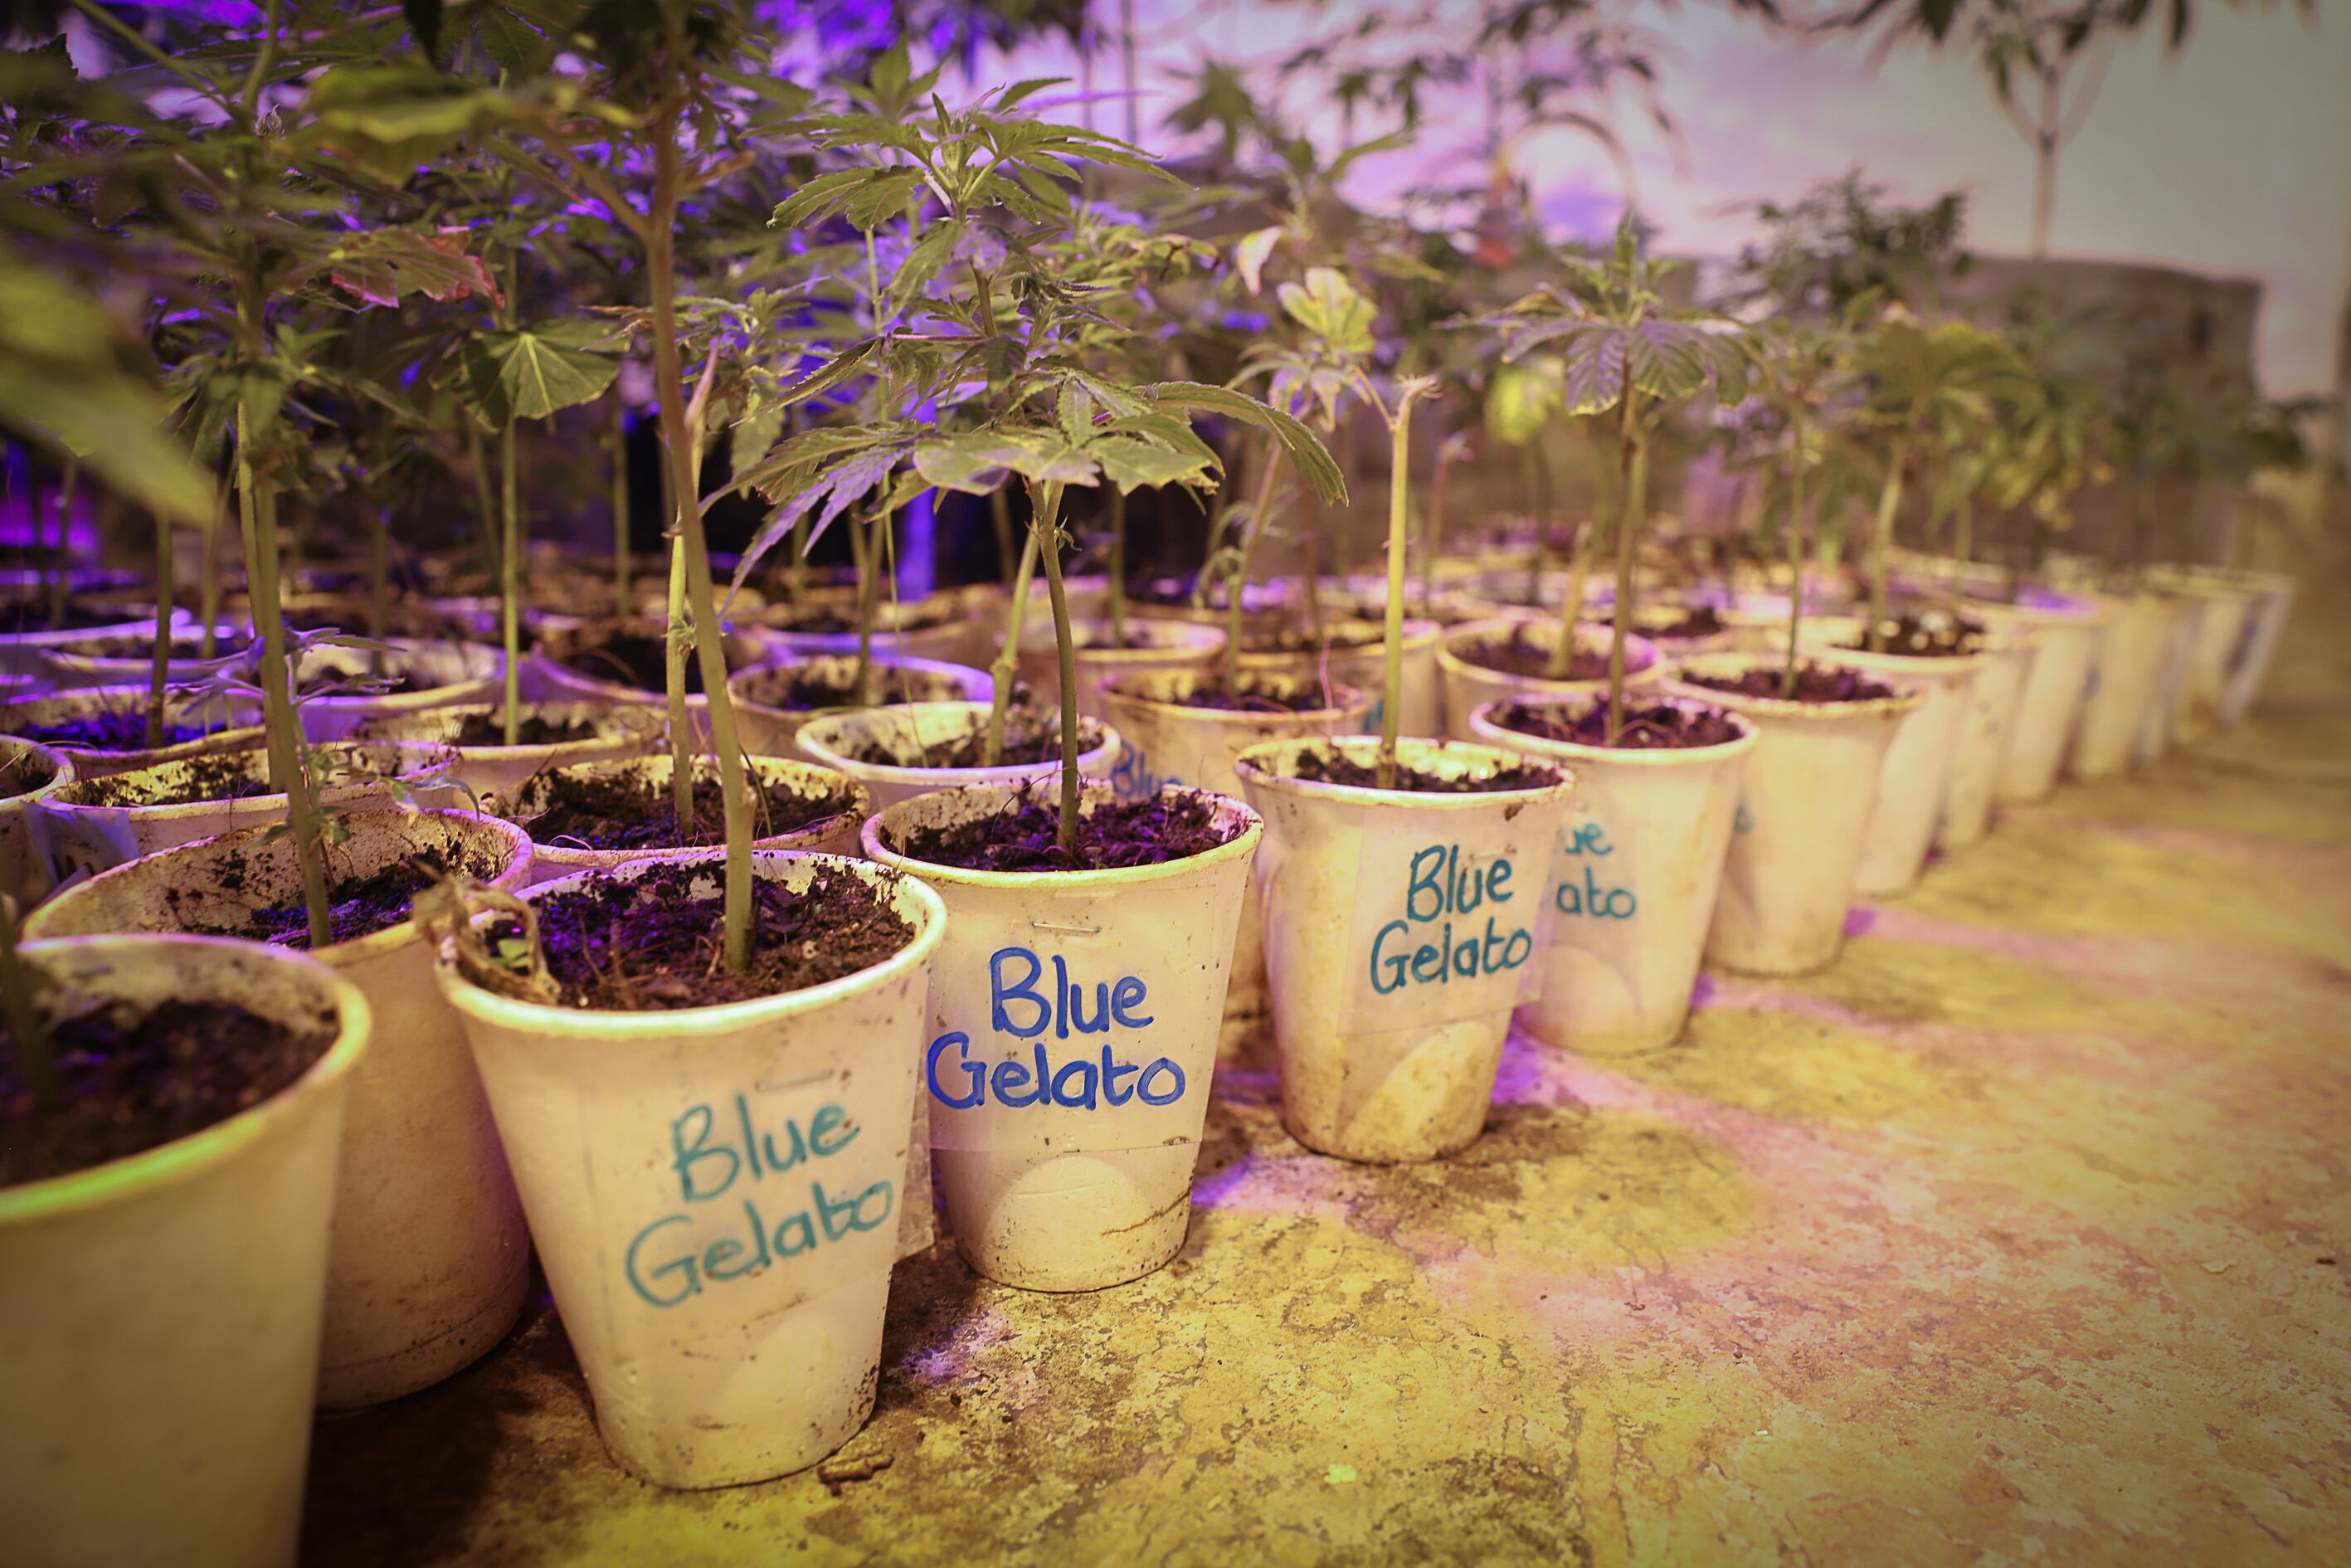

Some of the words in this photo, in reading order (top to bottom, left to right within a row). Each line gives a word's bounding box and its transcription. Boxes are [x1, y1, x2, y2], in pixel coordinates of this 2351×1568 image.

[1406, 844, 1513, 923] Blue
[990, 947, 1154, 1040] Blue
[1370, 916, 1533, 995] Gelato
[927, 1030, 1186, 1110] Gelato
[671, 1093, 860, 1203] Blue
[625, 1180, 893, 1307] Gelato
